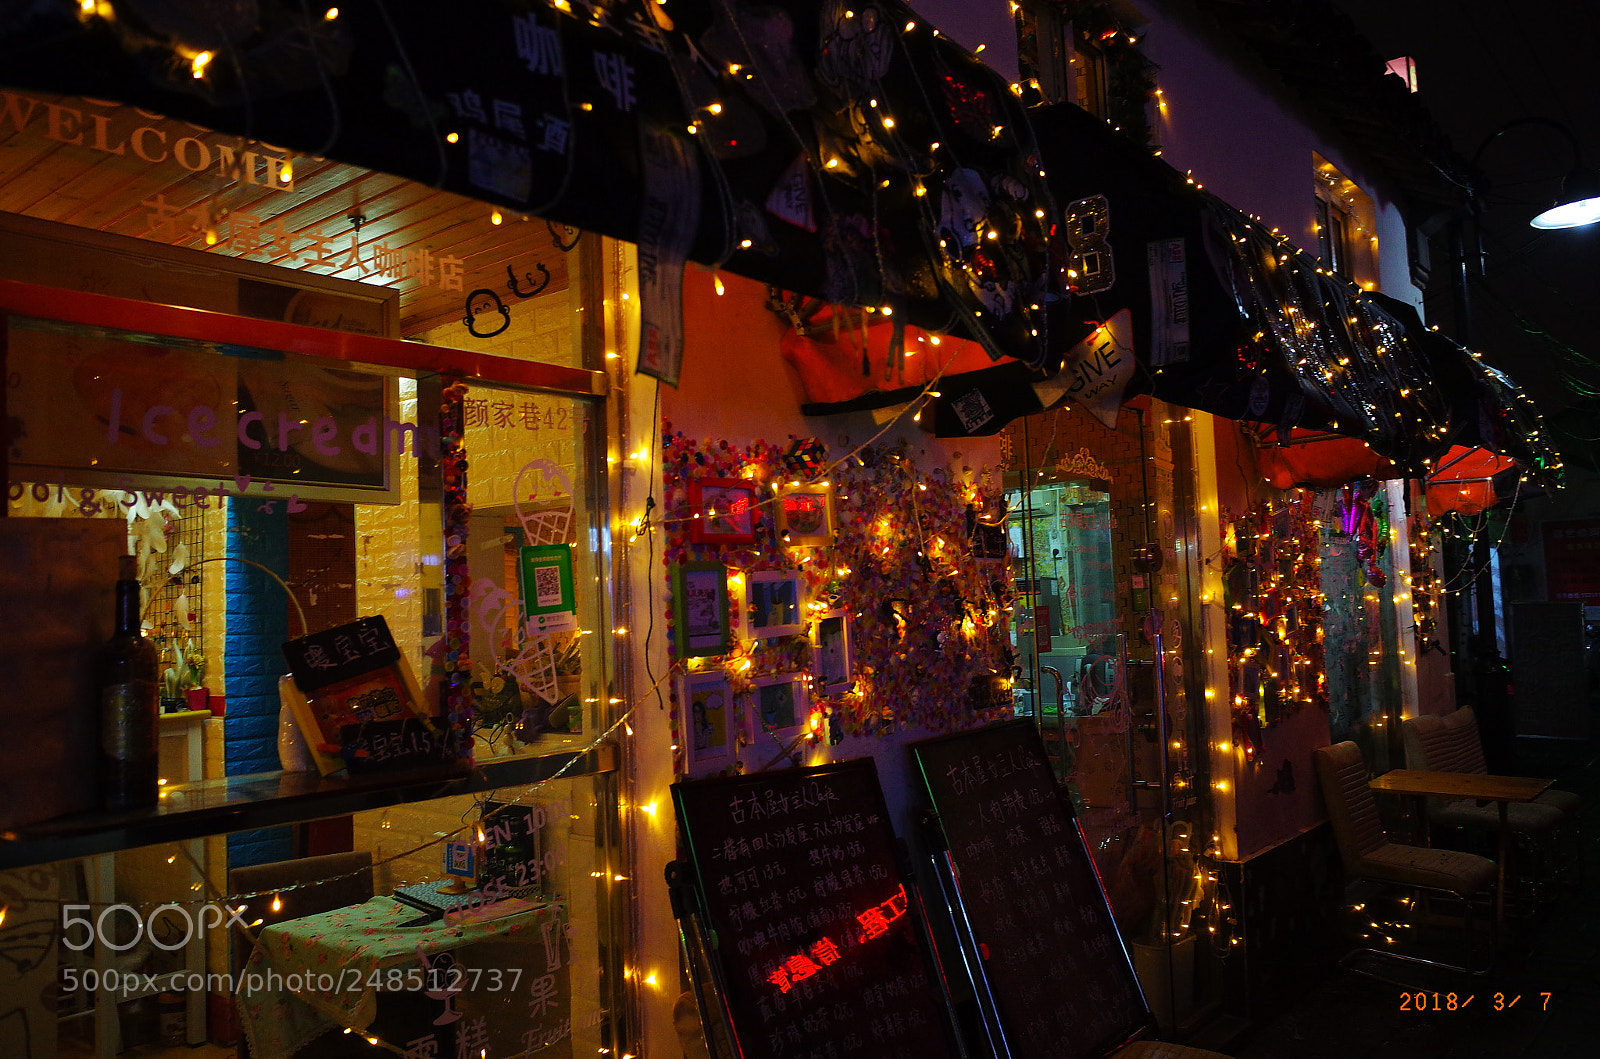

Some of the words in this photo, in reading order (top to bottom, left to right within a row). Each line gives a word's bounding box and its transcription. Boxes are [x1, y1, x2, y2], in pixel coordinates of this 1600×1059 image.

[512, 12, 636, 112] 咖啡
[0, 92, 294, 192] WELCOME
[446, 89, 571, 155] 鸡尾酒
[142, 194, 465, 292] 古本屋女主人咖啡店
[1072, 342, 1122, 392] GIVE
[1084, 374, 1117, 399] WAY
[8, 474, 63, 505] ool
[120, 476, 229, 509] Sweet
[452, 820, 512, 862] OPEN
[443, 875, 509, 928] CLOSE
